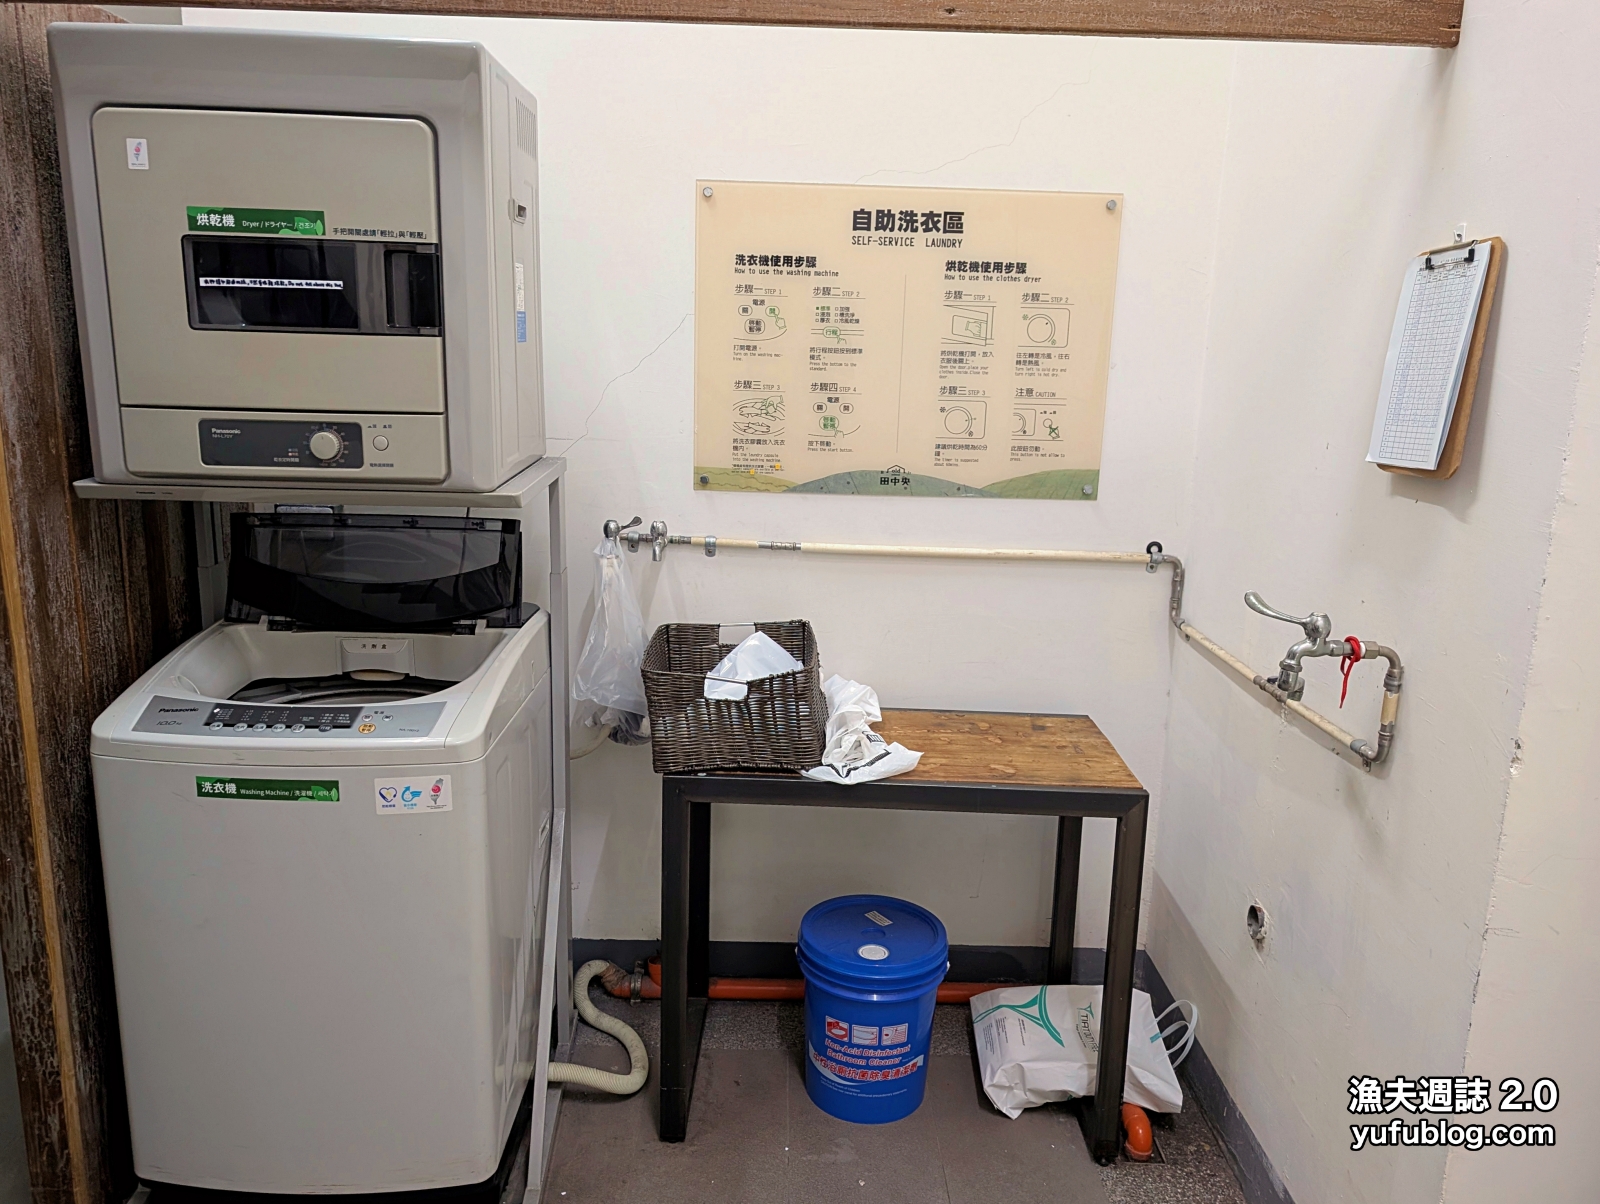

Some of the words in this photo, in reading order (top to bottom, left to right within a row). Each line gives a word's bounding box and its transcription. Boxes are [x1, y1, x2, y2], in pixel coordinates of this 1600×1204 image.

[196, 213, 236, 227] 烘乾機
[852, 208, 965, 234] 自助洗衣區
[852, 236, 915, 247] SELF-SERVICE
[925, 238, 963, 248] LAUNDRY
[735, 254, 817, 268] 洗衣機使用步驟
[945, 260, 1027, 274] 烘乾機使用步驟
[734, 284, 763, 294] 步驟一
[812, 286, 840, 297] 步驟二
[944, 291, 972, 300] 步驟一
[1022, 293, 1049, 302] 步驟二
[734, 380, 761, 390] 步驟三
[810, 382, 838, 392] 步驟四
[939, 386, 967, 396] 步驟三
[1015, 388, 1034, 397] 注意
[880, 476, 910, 486] 田中央
[201, 781, 237, 794] 洗衣機
[240, 788, 264, 796] Washing
[825, 1038, 861, 1056] Non-Acid
[863, 1044, 911, 1057] Disinfectant
[827, 1049, 867, 1066] Bathroom
[869, 1057, 902, 1066] Cleaner
[813, 1052, 918, 1082] 中性浴廁抗菌除臭清潔劑
